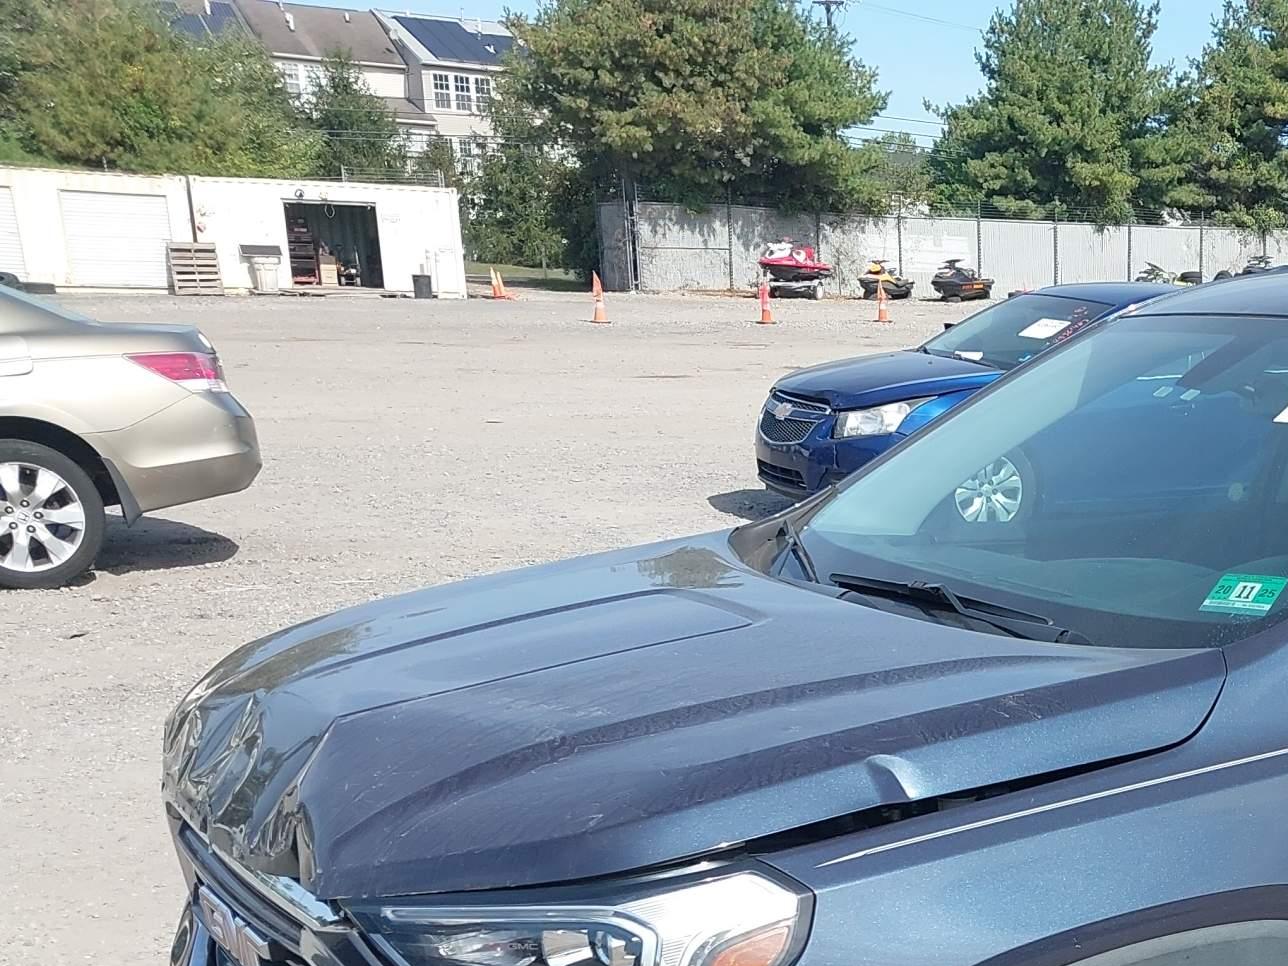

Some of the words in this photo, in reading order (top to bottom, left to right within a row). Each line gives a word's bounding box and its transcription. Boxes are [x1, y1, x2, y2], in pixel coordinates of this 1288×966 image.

[1215, 584, 1232, 595] 20
[1235, 585, 1257, 600] 11
[1258, 588, 1277, 598] 25
[508, 943, 539, 951] GMC
